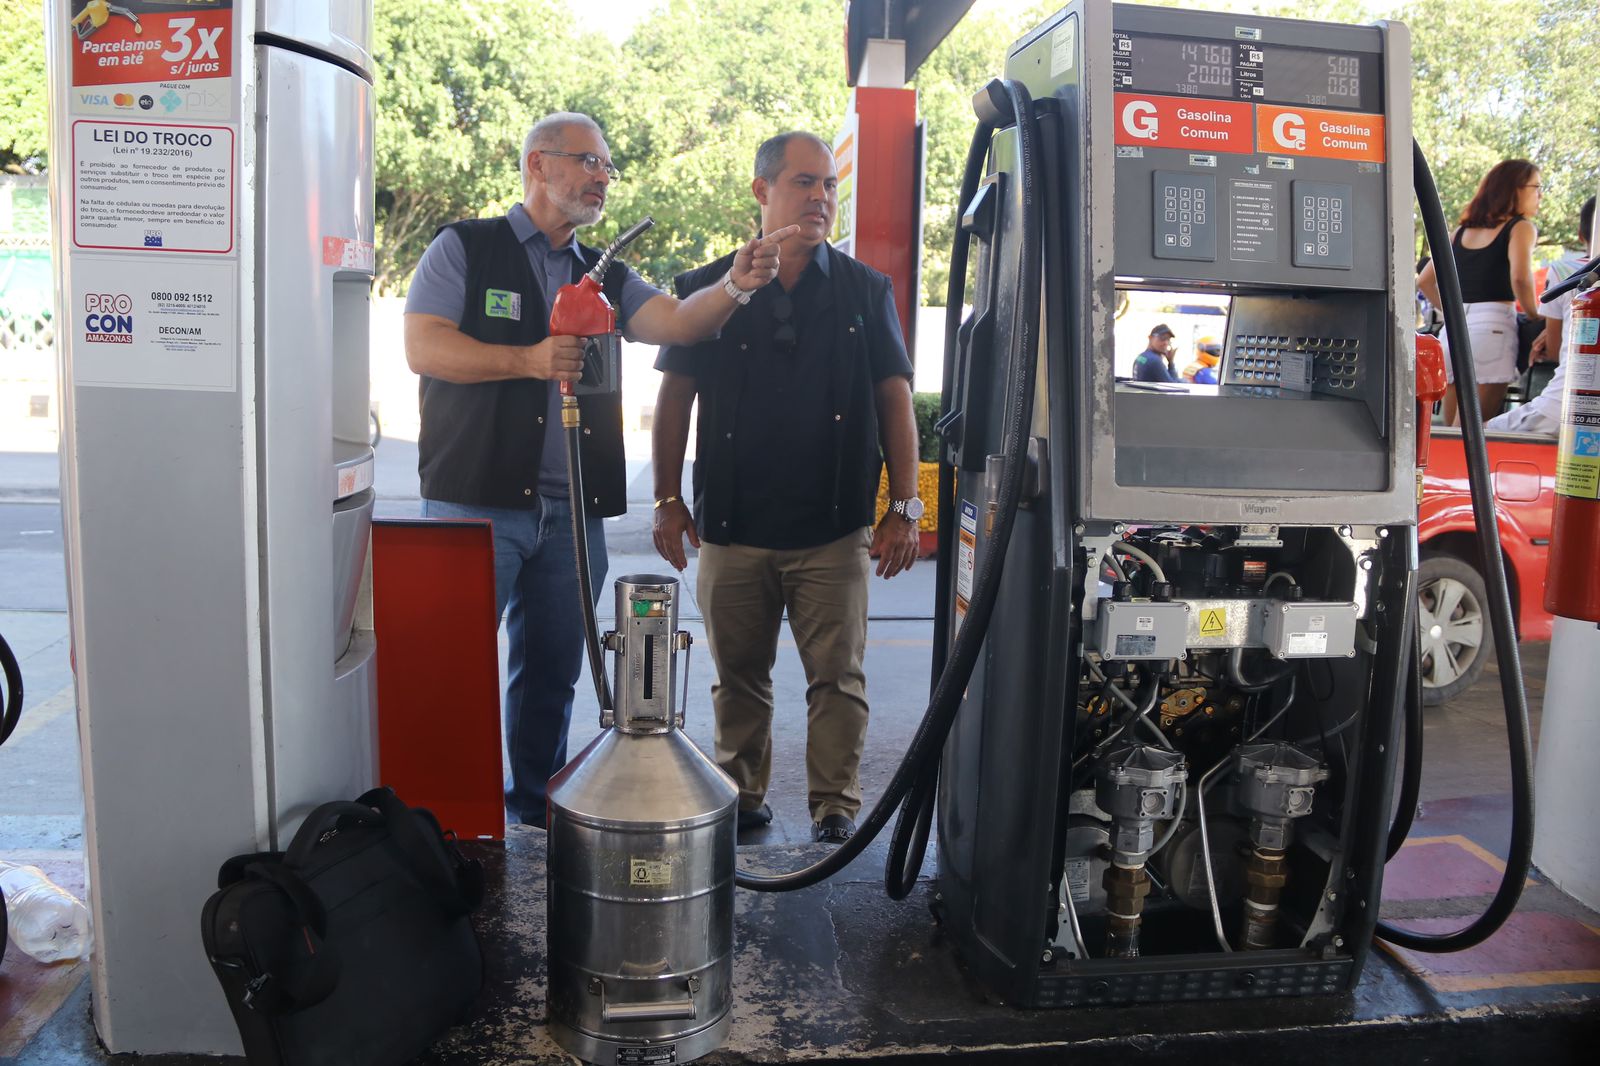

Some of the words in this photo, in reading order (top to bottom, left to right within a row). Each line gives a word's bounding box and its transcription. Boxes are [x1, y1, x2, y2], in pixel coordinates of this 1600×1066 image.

[82, 40, 161, 54] Parcelamos
[161, 18, 224, 62] 3x
[98, 56, 119, 66] em
[123, 52, 144, 65] até
[170, 62, 185, 74] s/
[185, 61, 219, 76] juros
[80, 94, 109, 105] VISA
[186, 90, 226, 112] pix
[1177, 108, 1232, 123] Gasolina
[1180, 126, 1228, 140] Comum
[1320, 122, 1370, 136] Gasolina
[94, 129, 118, 142] LEI
[124, 131, 148, 144] DO
[153, 132, 212, 146] TROCO
[1322, 137, 1368, 150] Comum
[141, 148, 192, 157] 19.232/2016)
[85, 293, 132, 314] PRO
[151, 292, 172, 300] 0800
[174, 293, 189, 301] 092
[193, 293, 212, 302] 1512
[86, 314, 132, 333] CON
[159, 327, 201, 335] DECON/AM
[86, 334, 132, 343] AMAZONAS
[1244, 504, 1277, 514] Wayne
